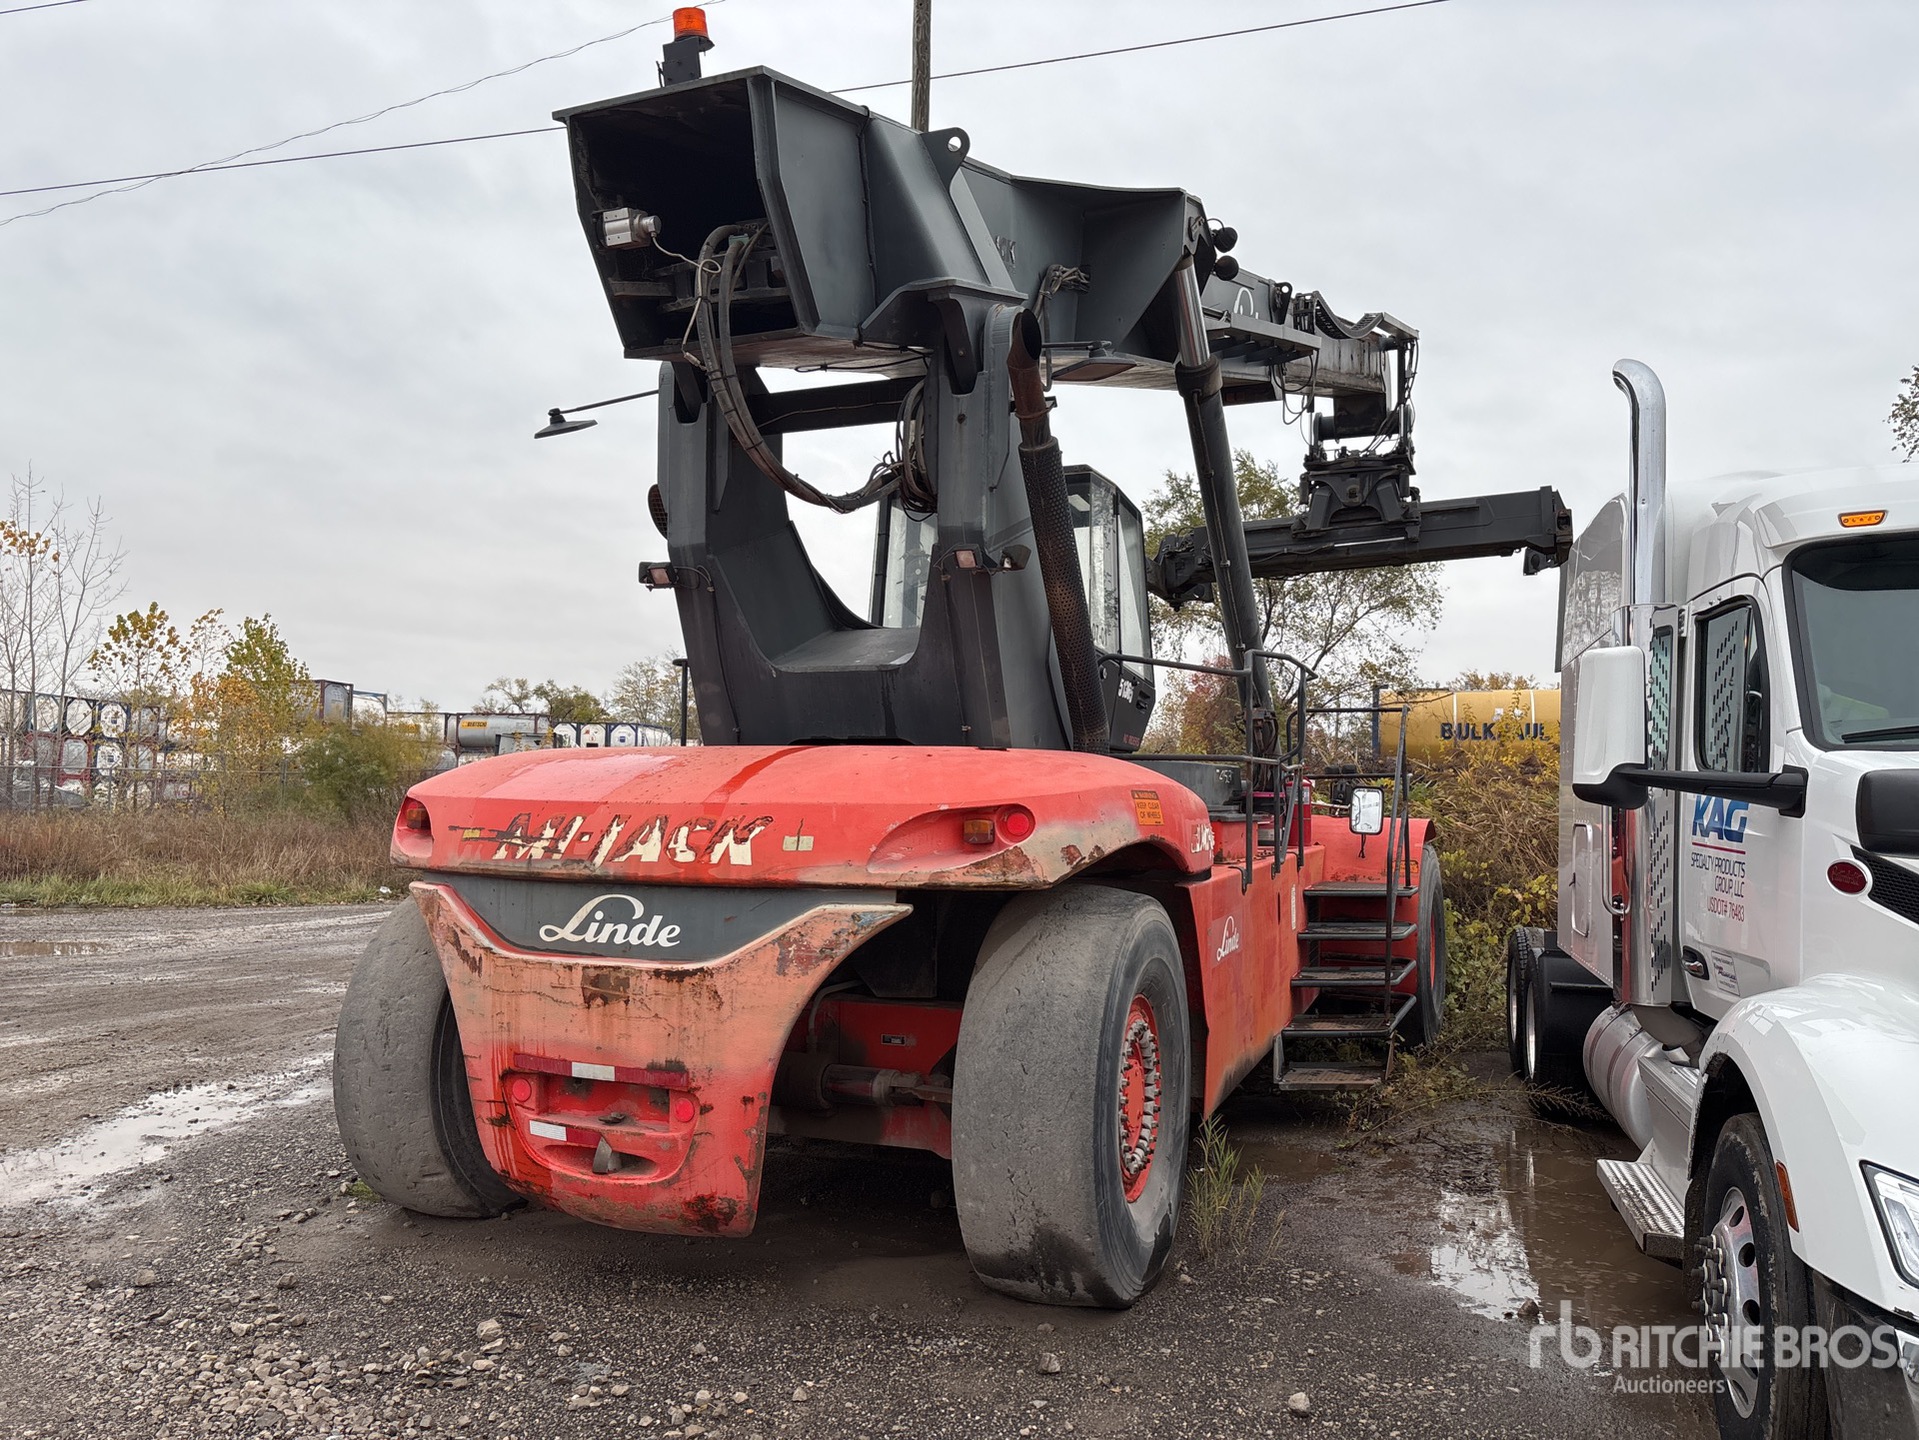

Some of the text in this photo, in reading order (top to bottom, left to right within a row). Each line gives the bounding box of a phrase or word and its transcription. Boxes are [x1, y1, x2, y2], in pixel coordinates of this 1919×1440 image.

[493, 812, 774, 869] MI-JACK
[1692, 794, 1750, 843] KAG
[1690, 851, 1746, 879] SPECIALTY PRODUCTS
[1734, 881, 1745, 898] LLC
[539, 894, 680, 947] Linde
[1216, 915, 1240, 961] Linde
